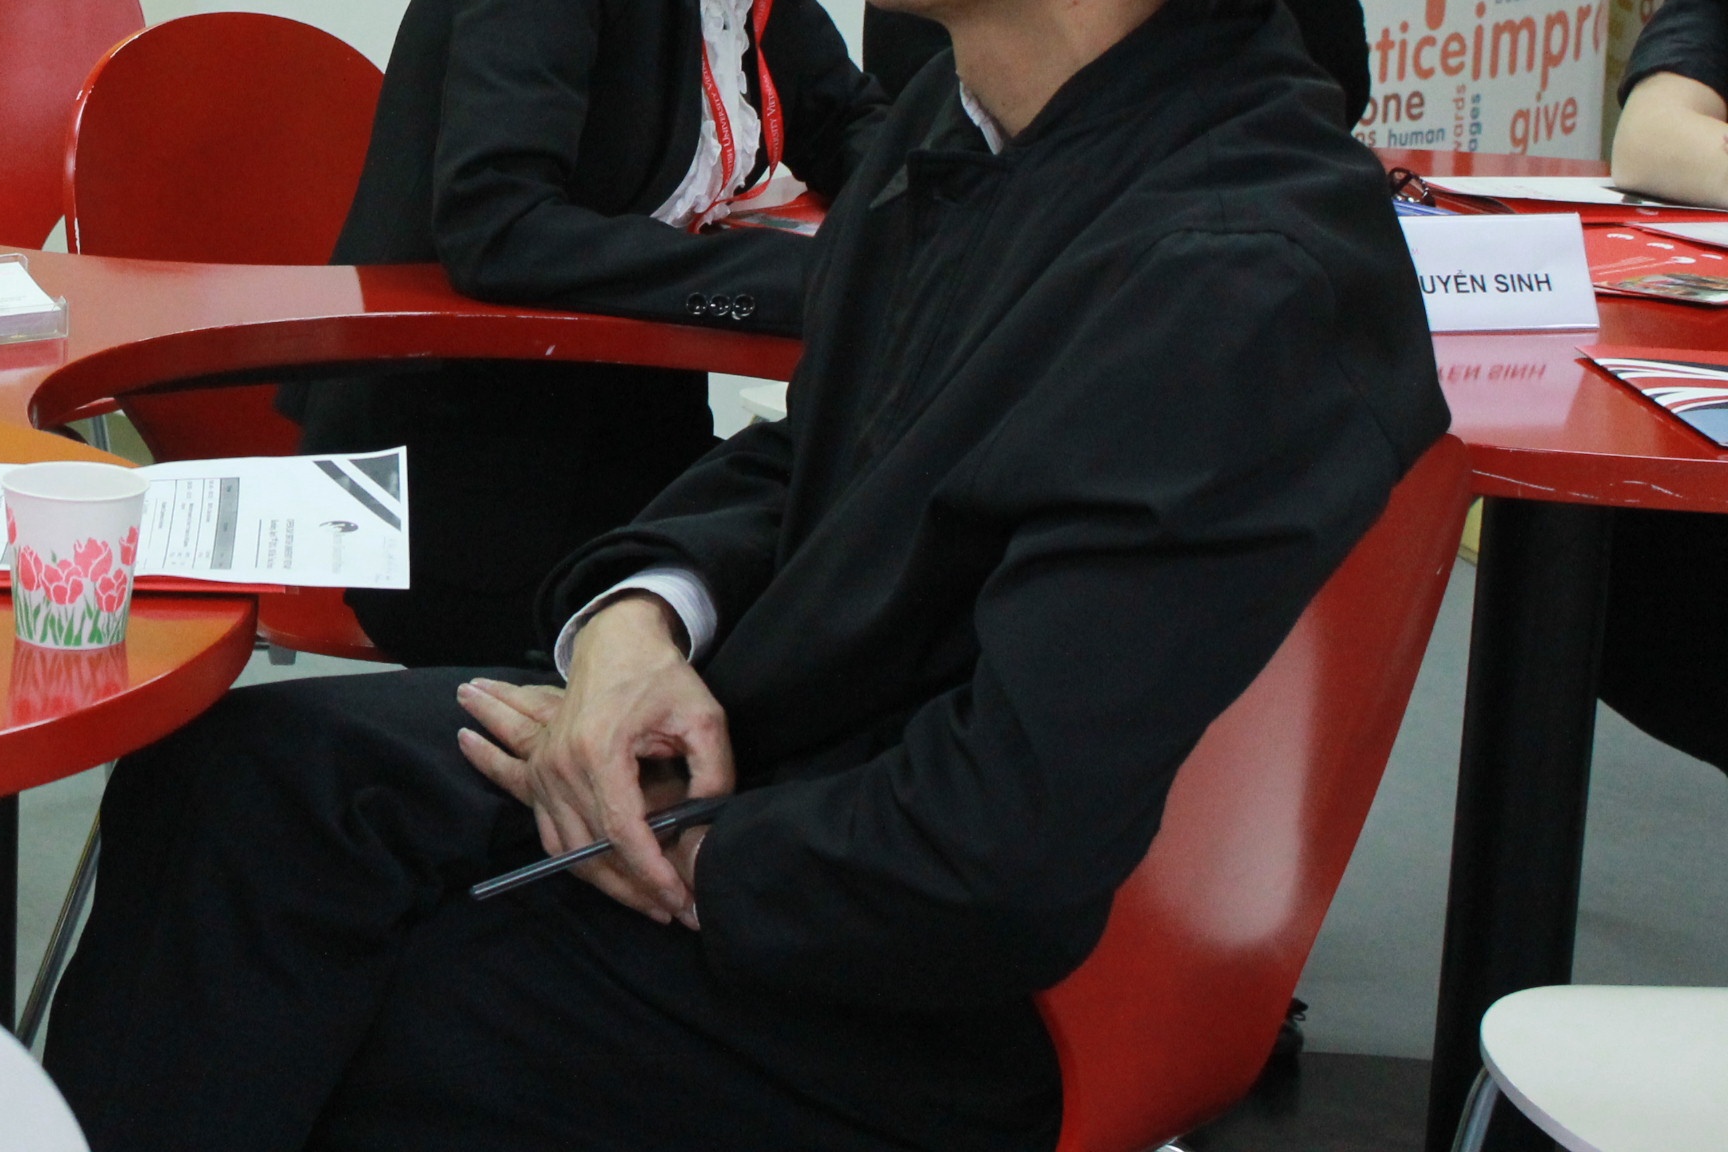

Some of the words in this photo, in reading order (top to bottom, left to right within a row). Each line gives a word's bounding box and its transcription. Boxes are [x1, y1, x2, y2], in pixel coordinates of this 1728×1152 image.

[1369, 19, 1468, 84] tice
[711, 91, 732, 148] UNIVERSITY
[762, 73, 777, 117] VIETNAM
[1387, 127, 1446, 148] human
[1510, 91, 1578, 156] give
[1494, 273, 1553, 294] SINH
